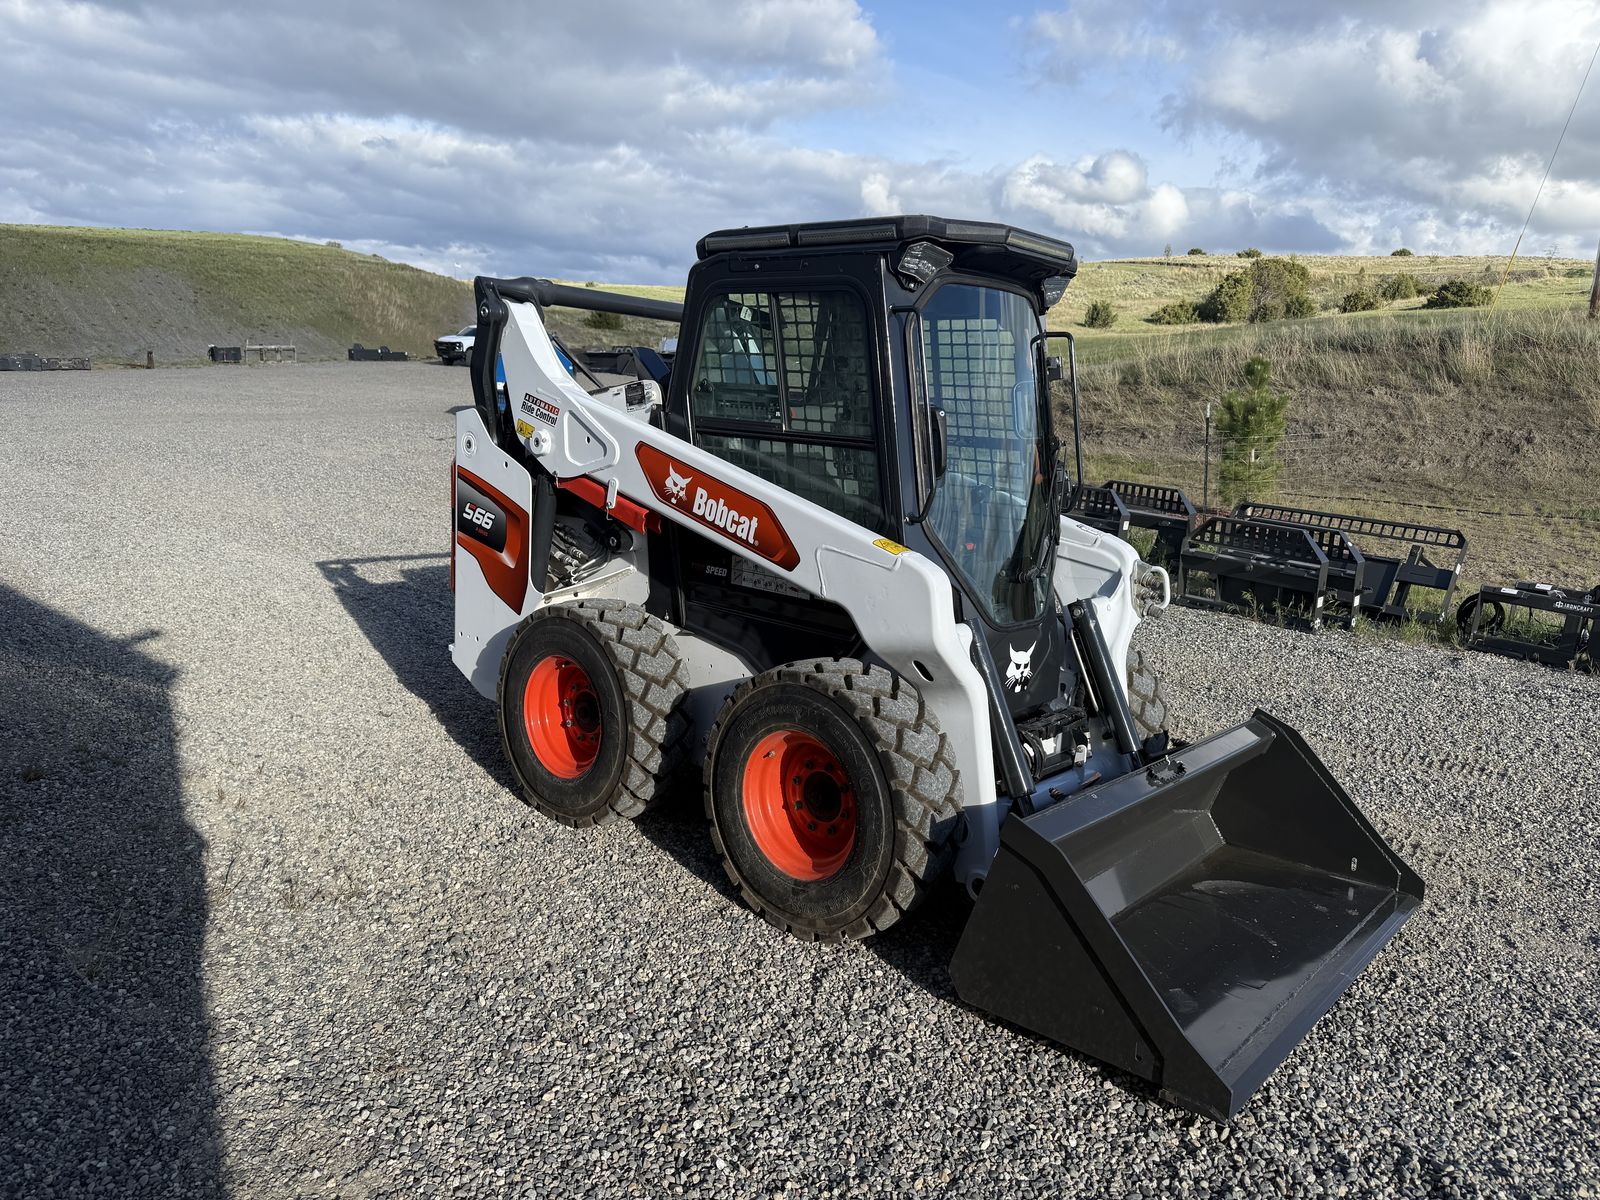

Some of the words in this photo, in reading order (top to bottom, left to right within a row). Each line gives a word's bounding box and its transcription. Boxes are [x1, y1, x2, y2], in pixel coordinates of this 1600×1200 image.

[521, 401, 535, 415] Ride
[535, 408, 558, 425] Control
[524, 394, 560, 416] AUTOMATIC
[462, 502, 496, 530] S66
[692, 486, 758, 545] Bobcat
[705, 565, 728, 577] SPEED
[1564, 603, 1594, 613] IRONCRAFT
